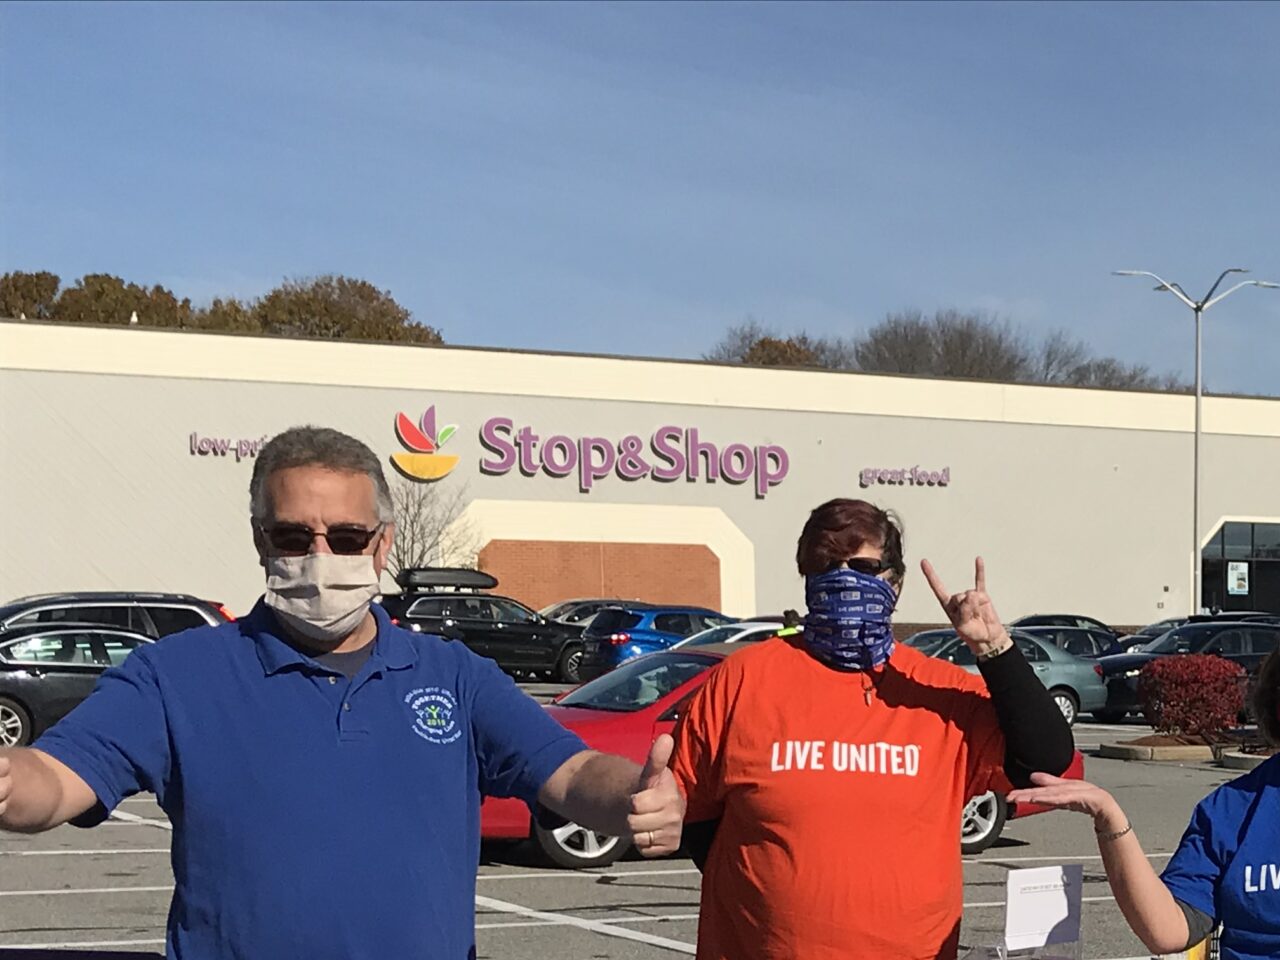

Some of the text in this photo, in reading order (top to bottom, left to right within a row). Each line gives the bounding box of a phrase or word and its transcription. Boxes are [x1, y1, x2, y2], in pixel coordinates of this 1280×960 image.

[190, 432, 230, 455] low
[480, 416, 790, 498] Stop&Shop
[859, 465, 950, 488] great food
[771, 740, 921, 777] LIVE UNITED
